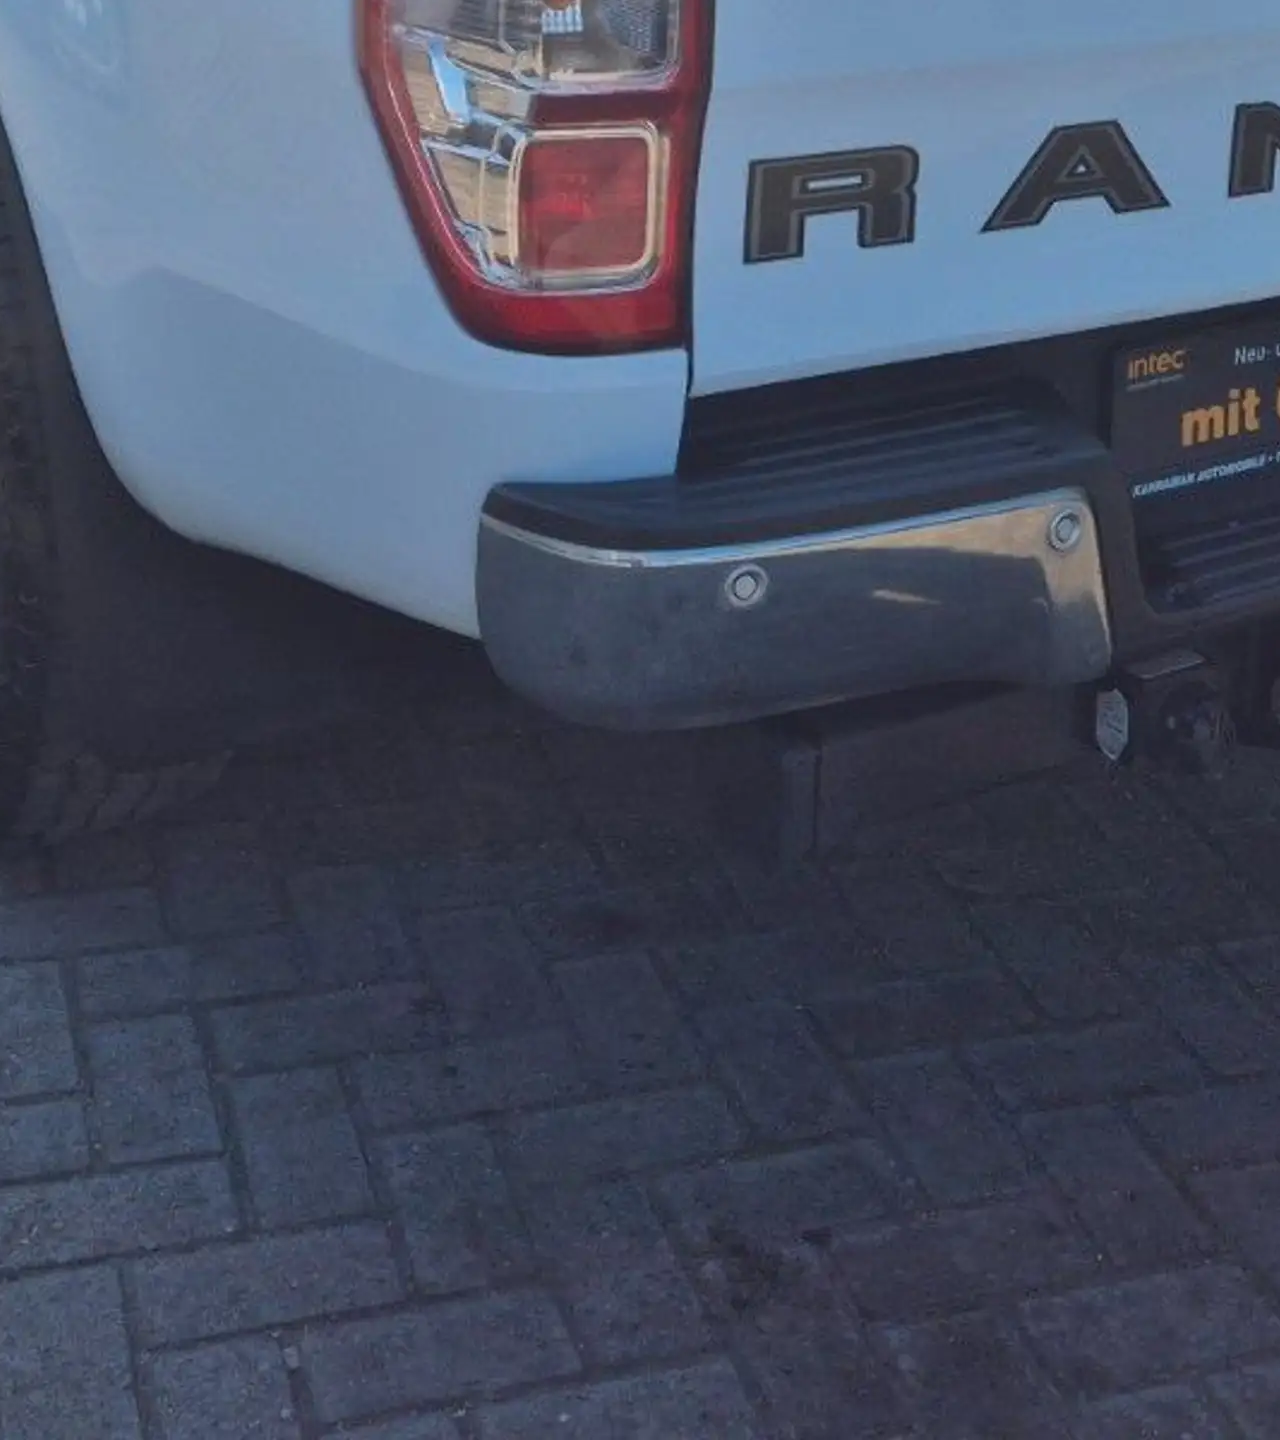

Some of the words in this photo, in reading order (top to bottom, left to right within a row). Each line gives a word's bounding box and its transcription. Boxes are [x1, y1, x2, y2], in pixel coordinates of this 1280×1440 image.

[1127, 349, 1187, 381] intec
[1233, 344, 1272, 366] Neu-
[1180, 385, 1262, 448] mit
